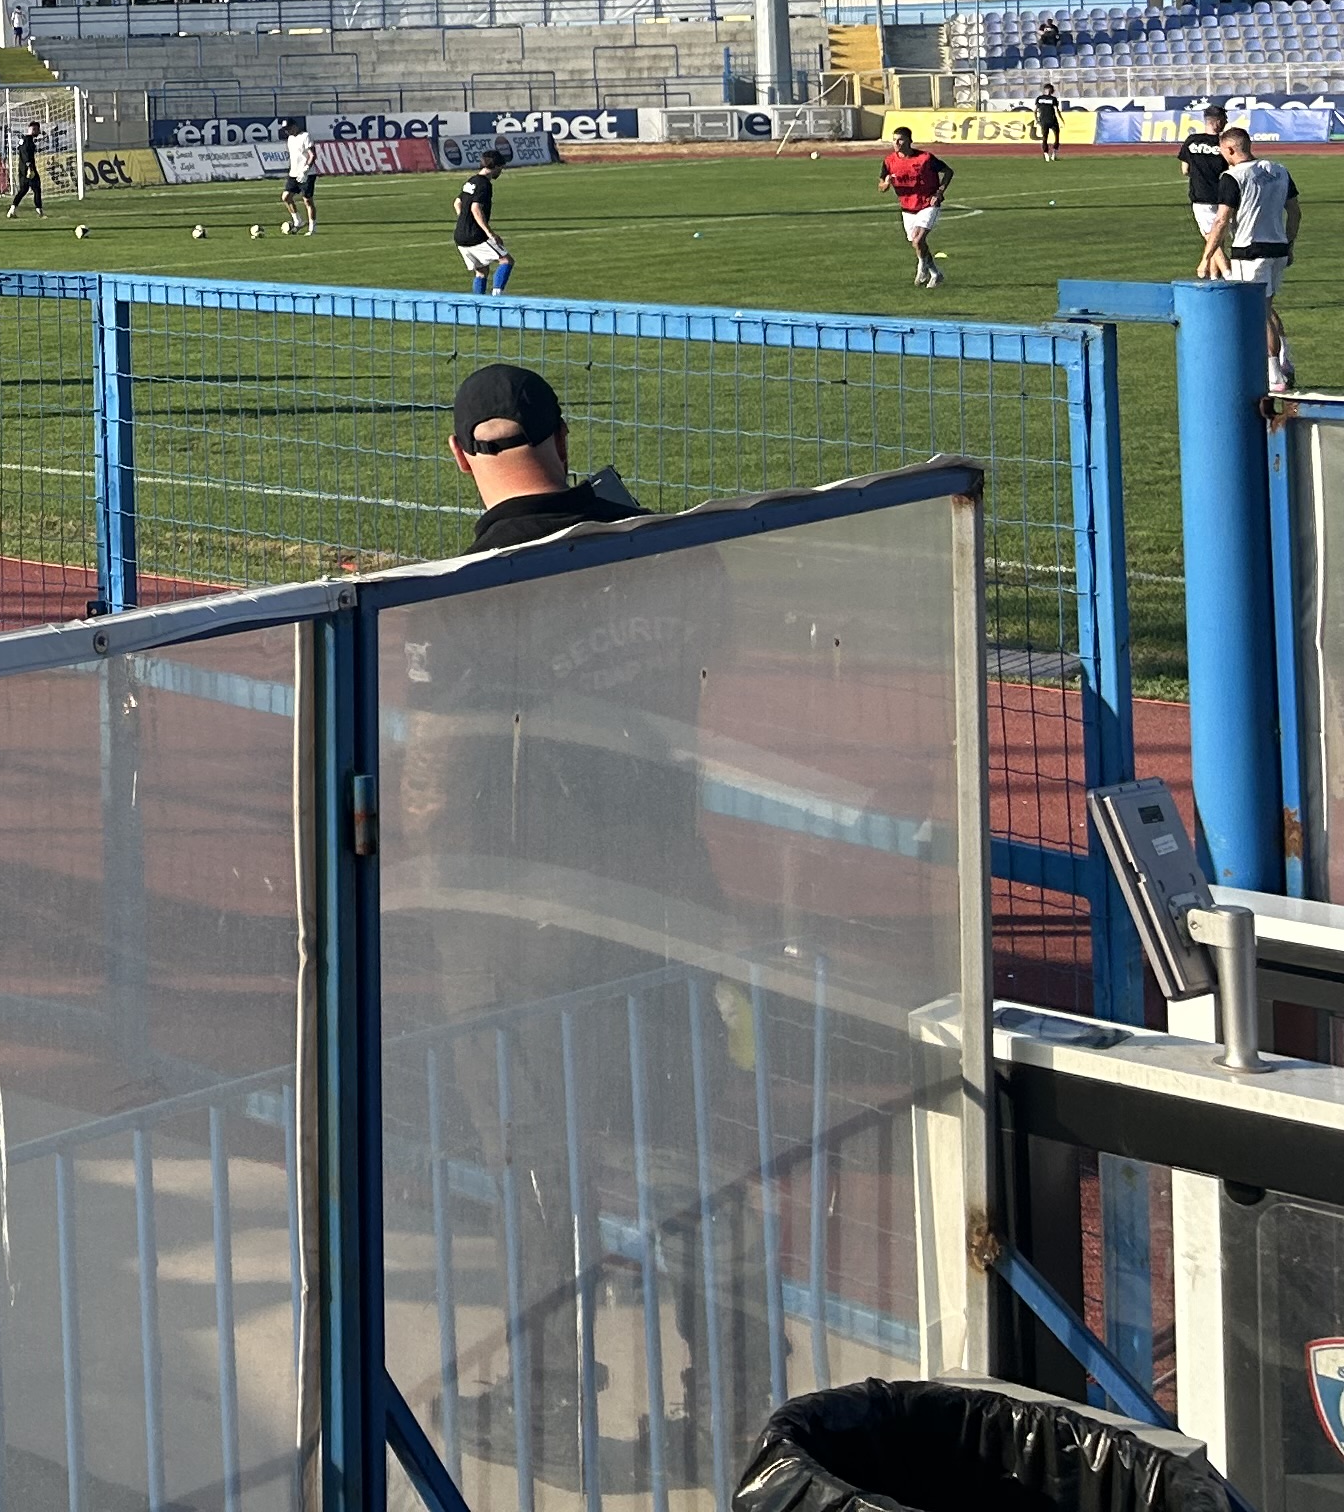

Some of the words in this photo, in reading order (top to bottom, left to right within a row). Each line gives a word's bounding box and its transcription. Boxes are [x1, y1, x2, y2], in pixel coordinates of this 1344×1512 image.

[178, 118, 283, 145] efbet
[333, 113, 448, 139] efbet
[496, 110, 618, 139] efbet
[934, 116, 1043, 141] efbet
[1140, 111, 1250, 142] inbt
[1250, 132, 1280, 142] .com
[462, 138, 493, 152] SPORT
[513, 136, 541, 149] SPORT
[518, 148, 546, 161] DEPOT
[1188, 142, 1221, 155] efbe
[263, 151, 290, 162] PHILIP
[313, 141, 403, 174] WINBET
